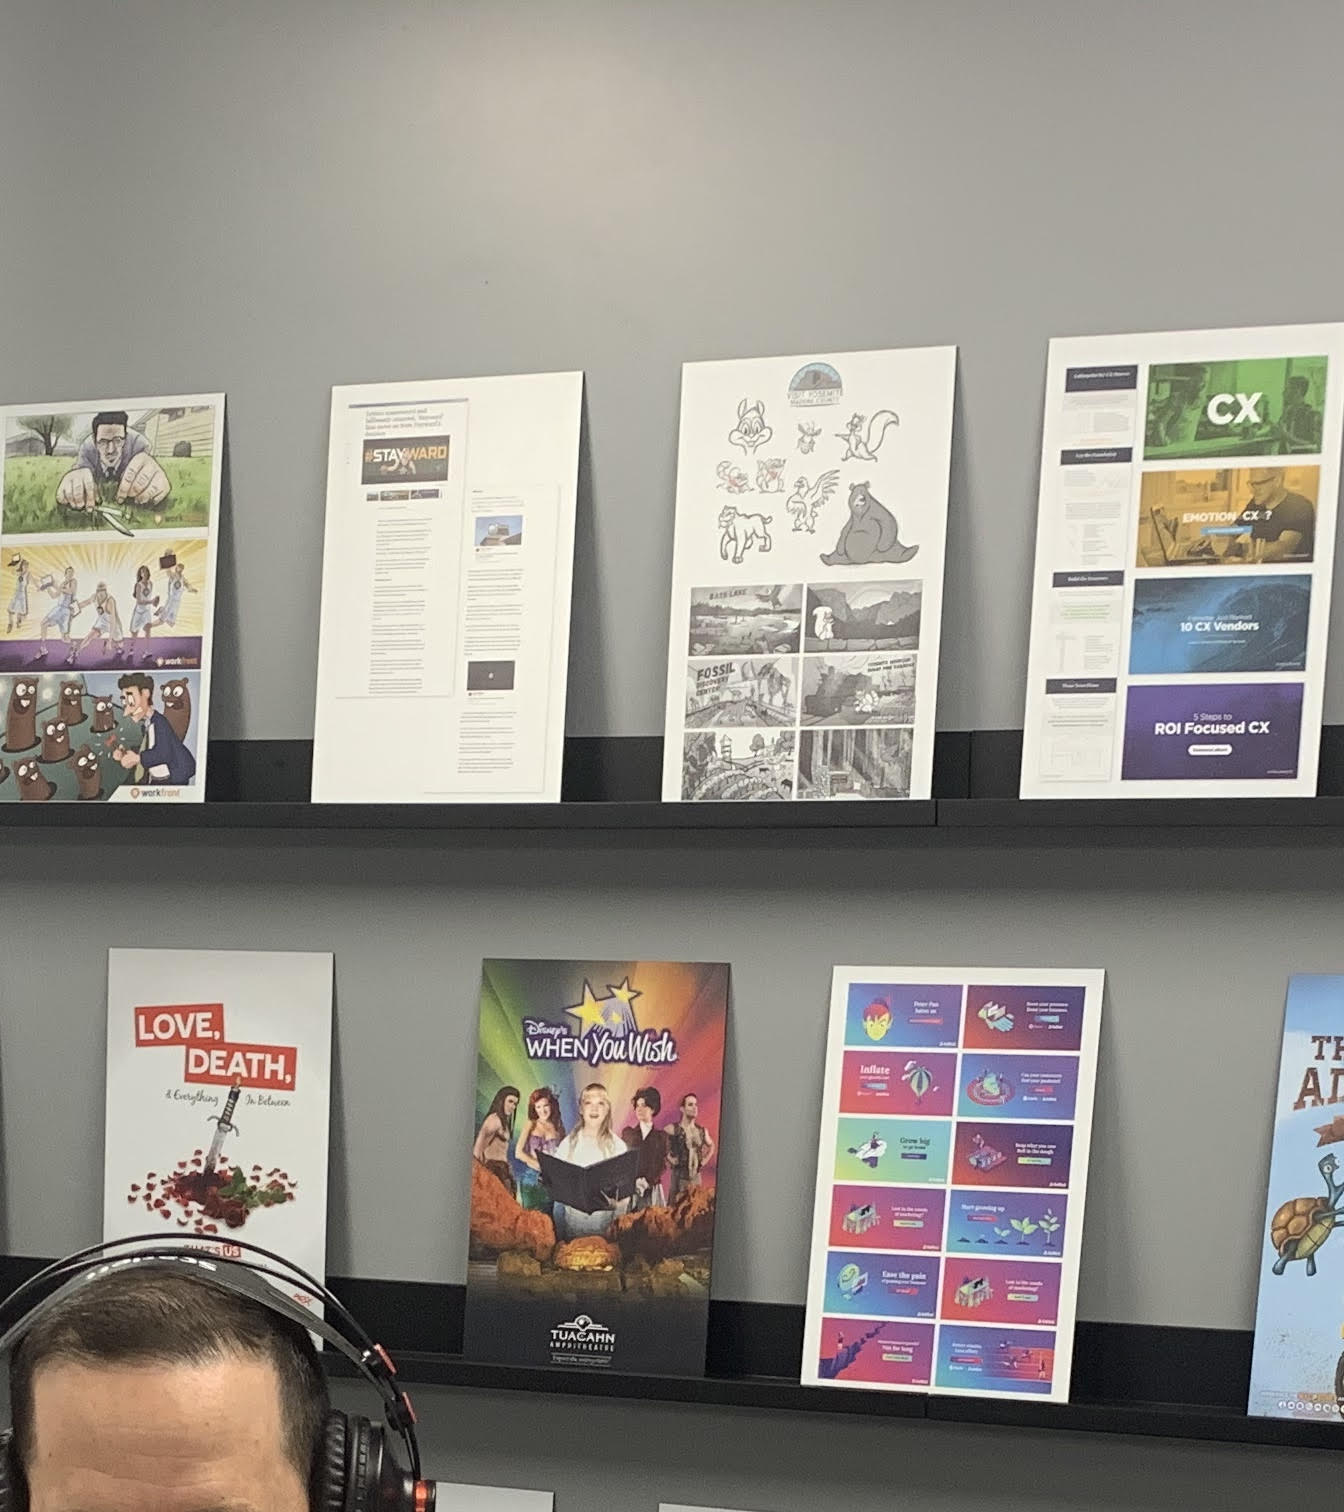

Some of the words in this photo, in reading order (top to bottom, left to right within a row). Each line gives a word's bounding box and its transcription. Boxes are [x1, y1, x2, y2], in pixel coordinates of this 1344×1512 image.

[1207, 392, 1263, 425] CX
[1182, 511, 1236, 524] EMOTION
[1243, 510, 1259, 521] CX
[1180, 622, 1192, 632] 10
[1195, 622, 1210, 631] CX
[1214, 621, 1259, 631] Vendors
[697, 662, 736, 681] FOSSIL
[1193, 713, 1199, 721] 5
[1201, 712, 1222, 722] Steps
[1224, 712, 1232, 720] to
[1155, 722, 1181, 735] ROI
[1184, 721, 1245, 735] Focused
[1249, 721, 1270, 734] CX
[141, 787, 180, 798] workfront
[138, 1012, 220, 1040] LOVE,
[524, 1020, 568, 1038] Disney's
[527, 1038, 589, 1058] WHEN
[593, 1031, 626, 1064] You
[628, 1031, 677, 1063] Wish
[188, 1048, 291, 1083] DEATH,
[860, 1065, 890, 1074] Inflate
[174, 1090, 219, 1106] Everything
[246, 1095, 256, 1105] In
[258, 1096, 291, 1107] Between
[224, 1246, 239, 1256] US
[550, 1330, 616, 1343] TUACAHN
